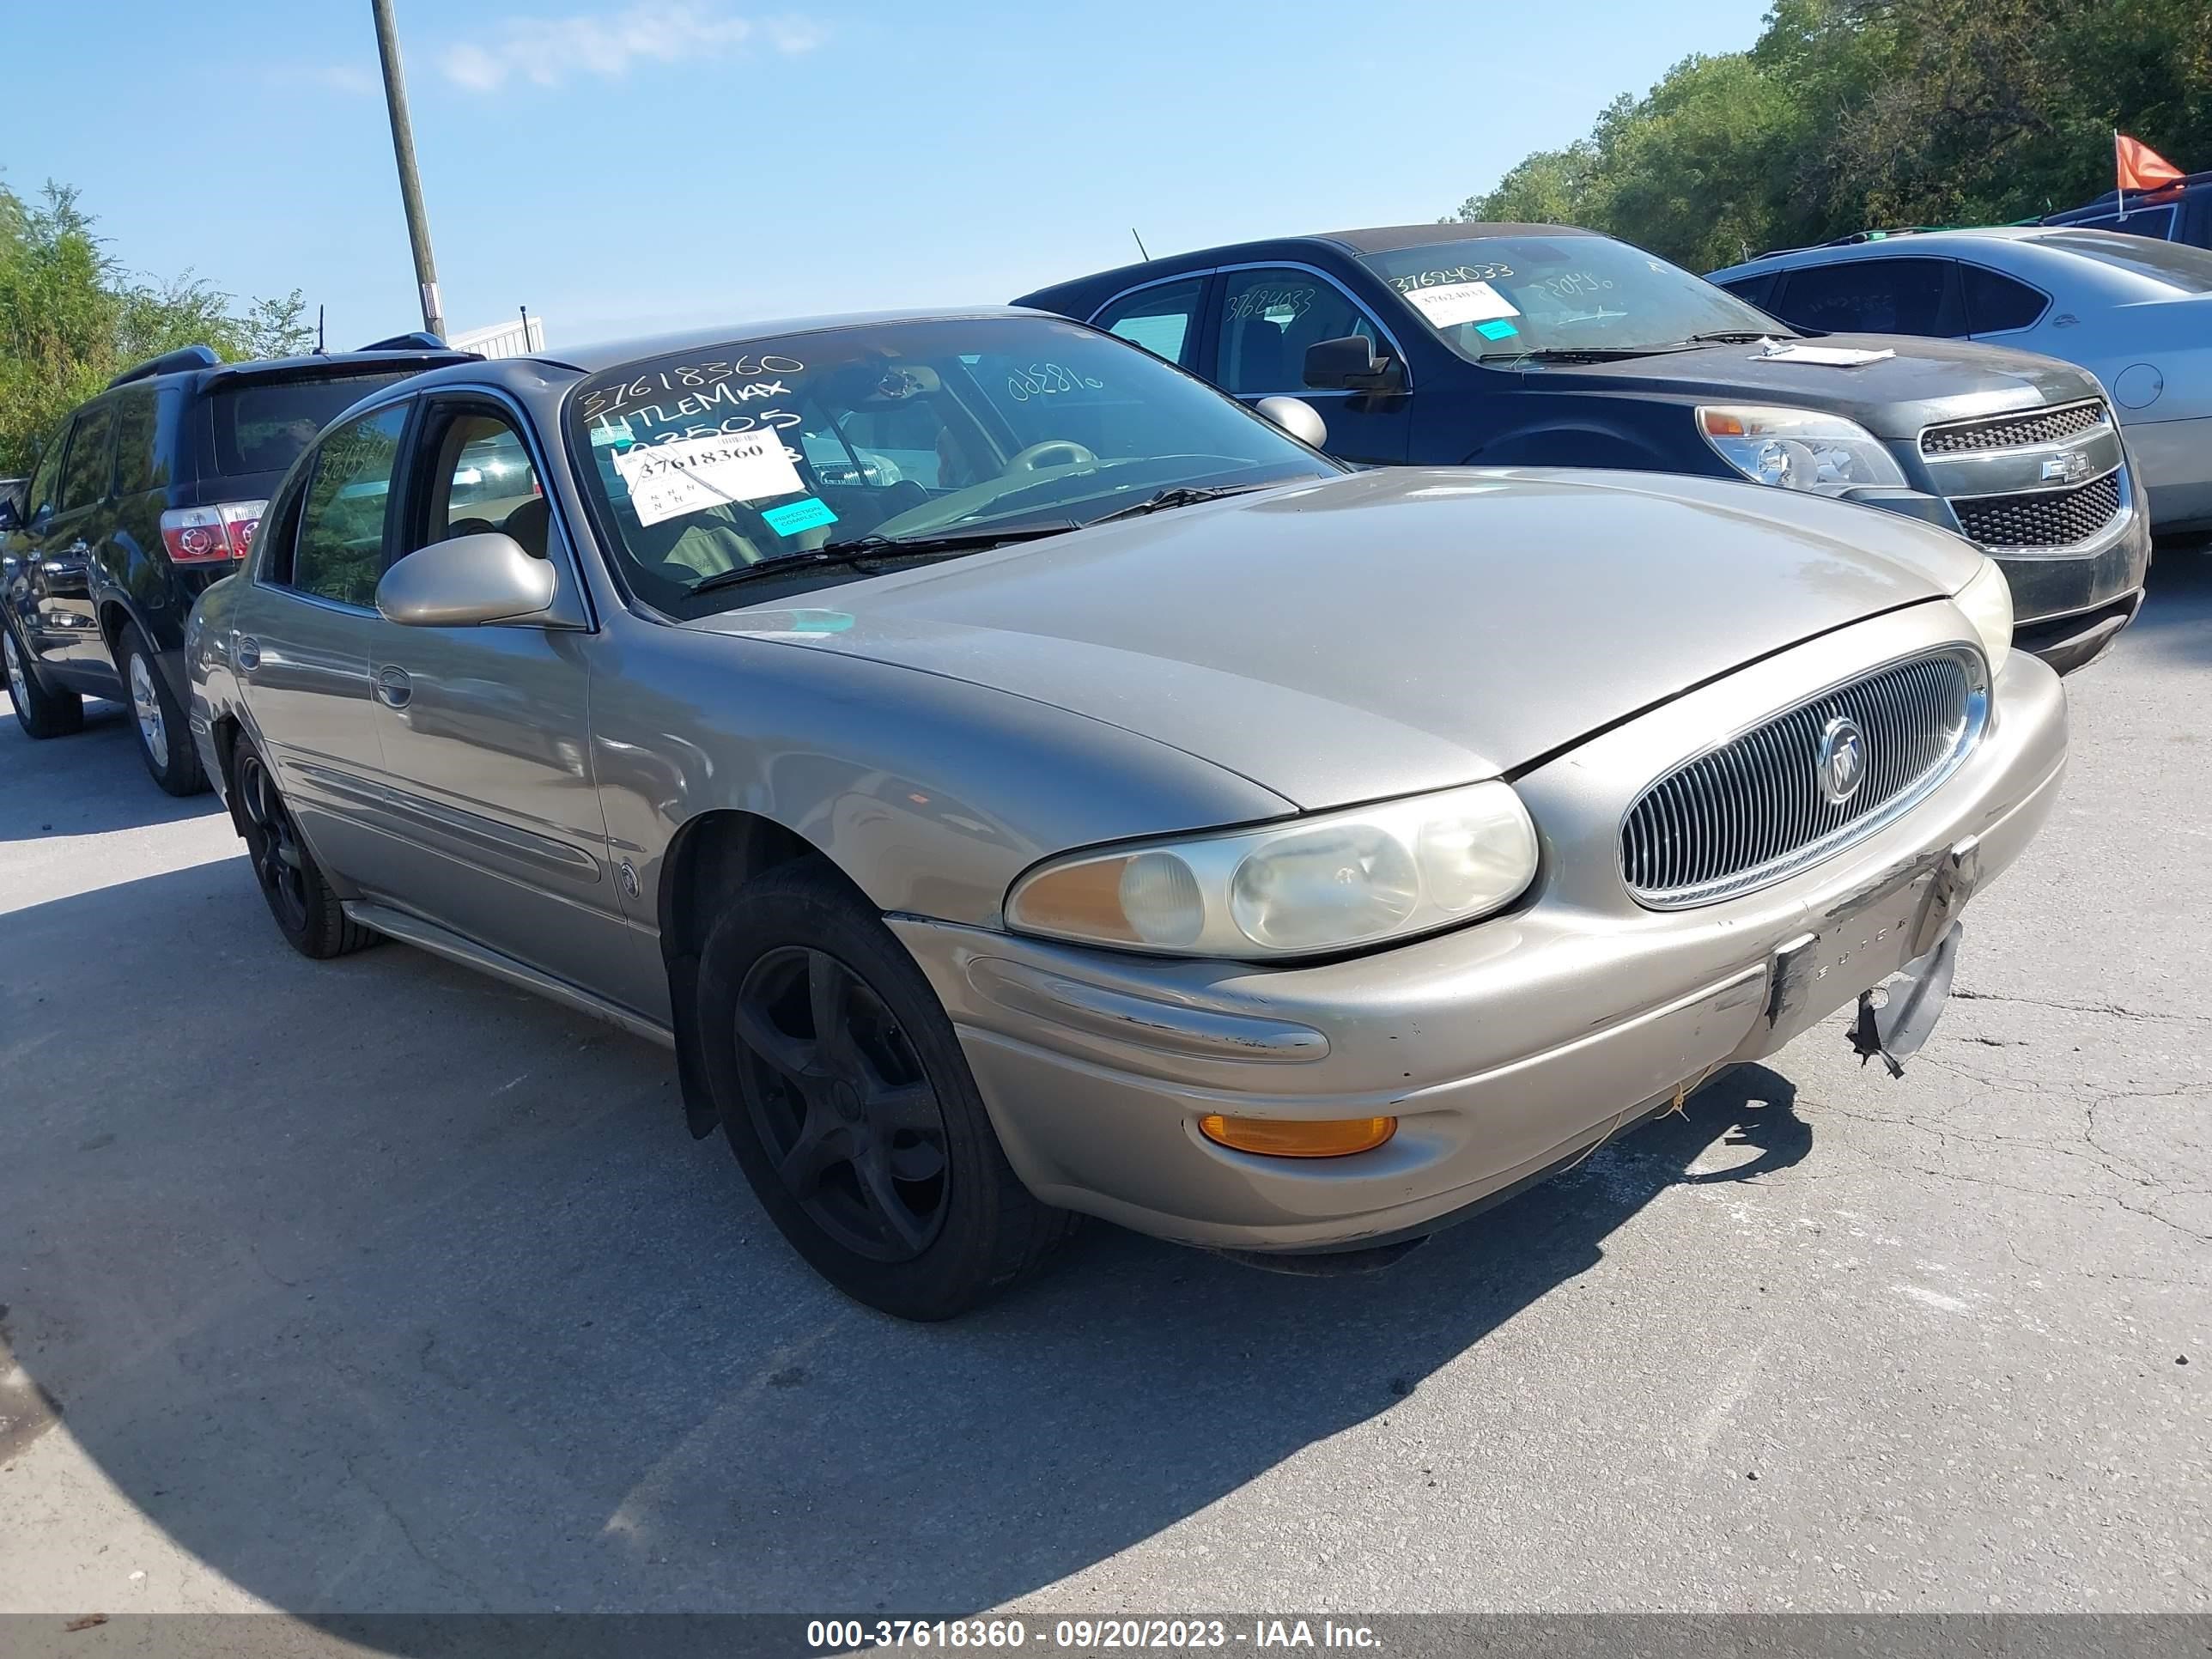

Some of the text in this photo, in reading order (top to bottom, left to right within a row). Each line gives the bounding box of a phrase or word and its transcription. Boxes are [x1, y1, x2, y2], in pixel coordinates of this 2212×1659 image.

[1389, 263, 1514, 294] 37624033
[1226, 289, 1316, 323] 37624033
[578, 356, 805, 416] 37618360
[641, 445, 764, 478] 37618360
[773, 506, 821, 523] INSPECTION
[781, 512, 824, 527] COMPLETE
